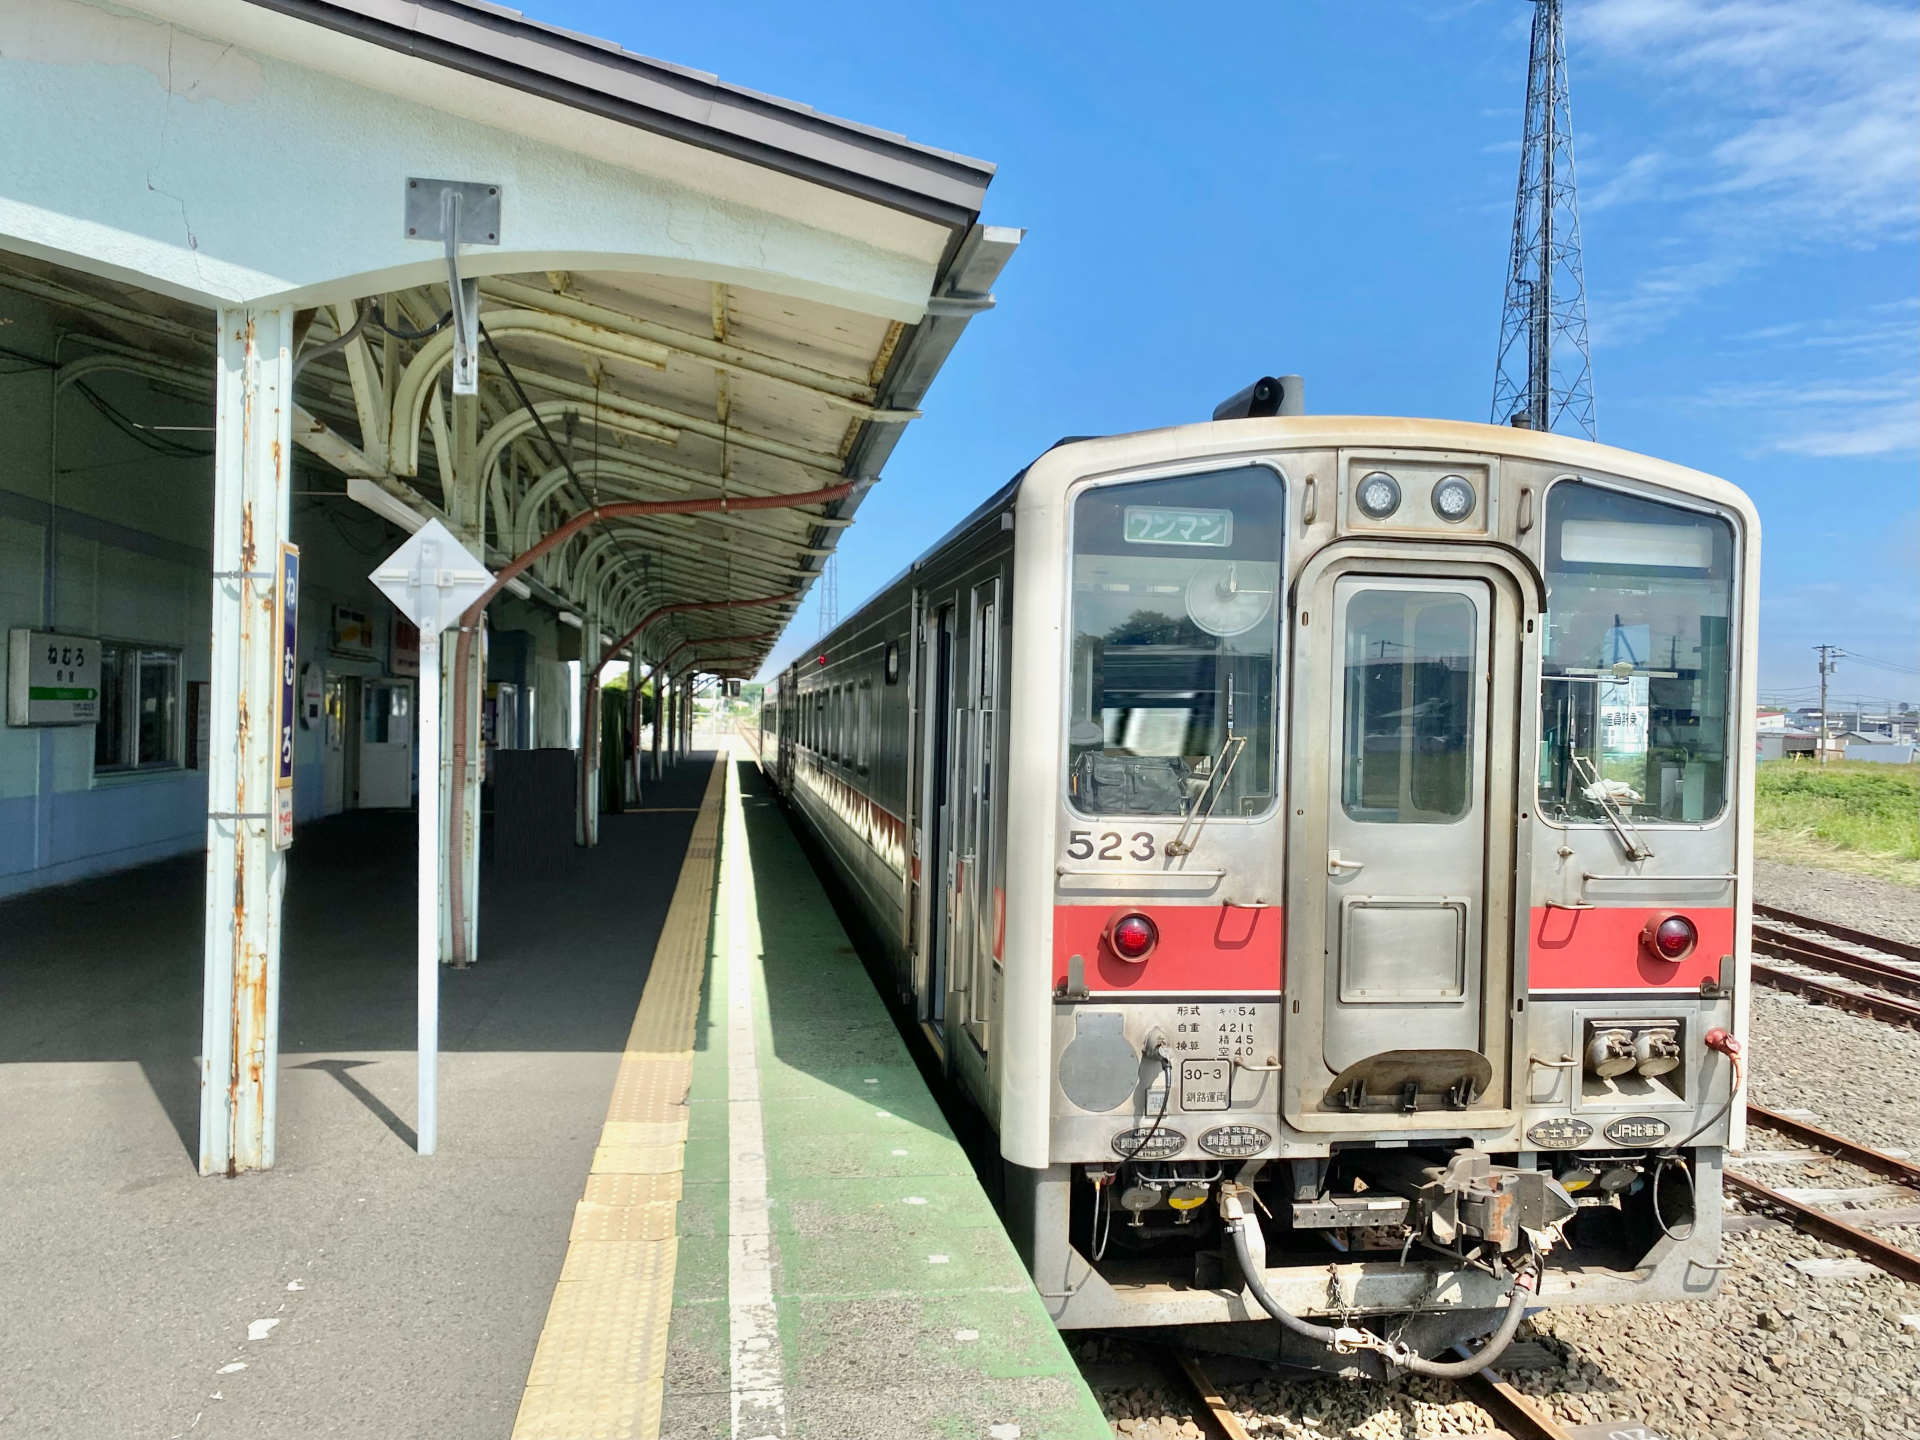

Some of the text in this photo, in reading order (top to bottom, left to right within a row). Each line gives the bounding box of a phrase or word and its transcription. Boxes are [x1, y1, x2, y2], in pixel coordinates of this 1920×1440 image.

[1130, 513, 1223, 541] ワンマン
[47, 644, 84, 667] ねむろ
[281, 569, 296, 764] ねむろ
[1066, 830, 1156, 862] 523
[1176, 1005, 1201, 1016] 形式
[1178, 1022, 1201, 1033] 自重
[1176, 1040, 1200, 1051] 換算
[1218, 1047, 1230, 1057] 空
[1184, 1068, 1222, 1080] 30-3
[1186, 1091, 1226, 1103] 釧路運両
[1534, 1126, 1589, 1139] 富士重工
[1612, 1123, 1665, 1138] JR北海道
[1206, 1134, 1266, 1147] 釧路車両所
